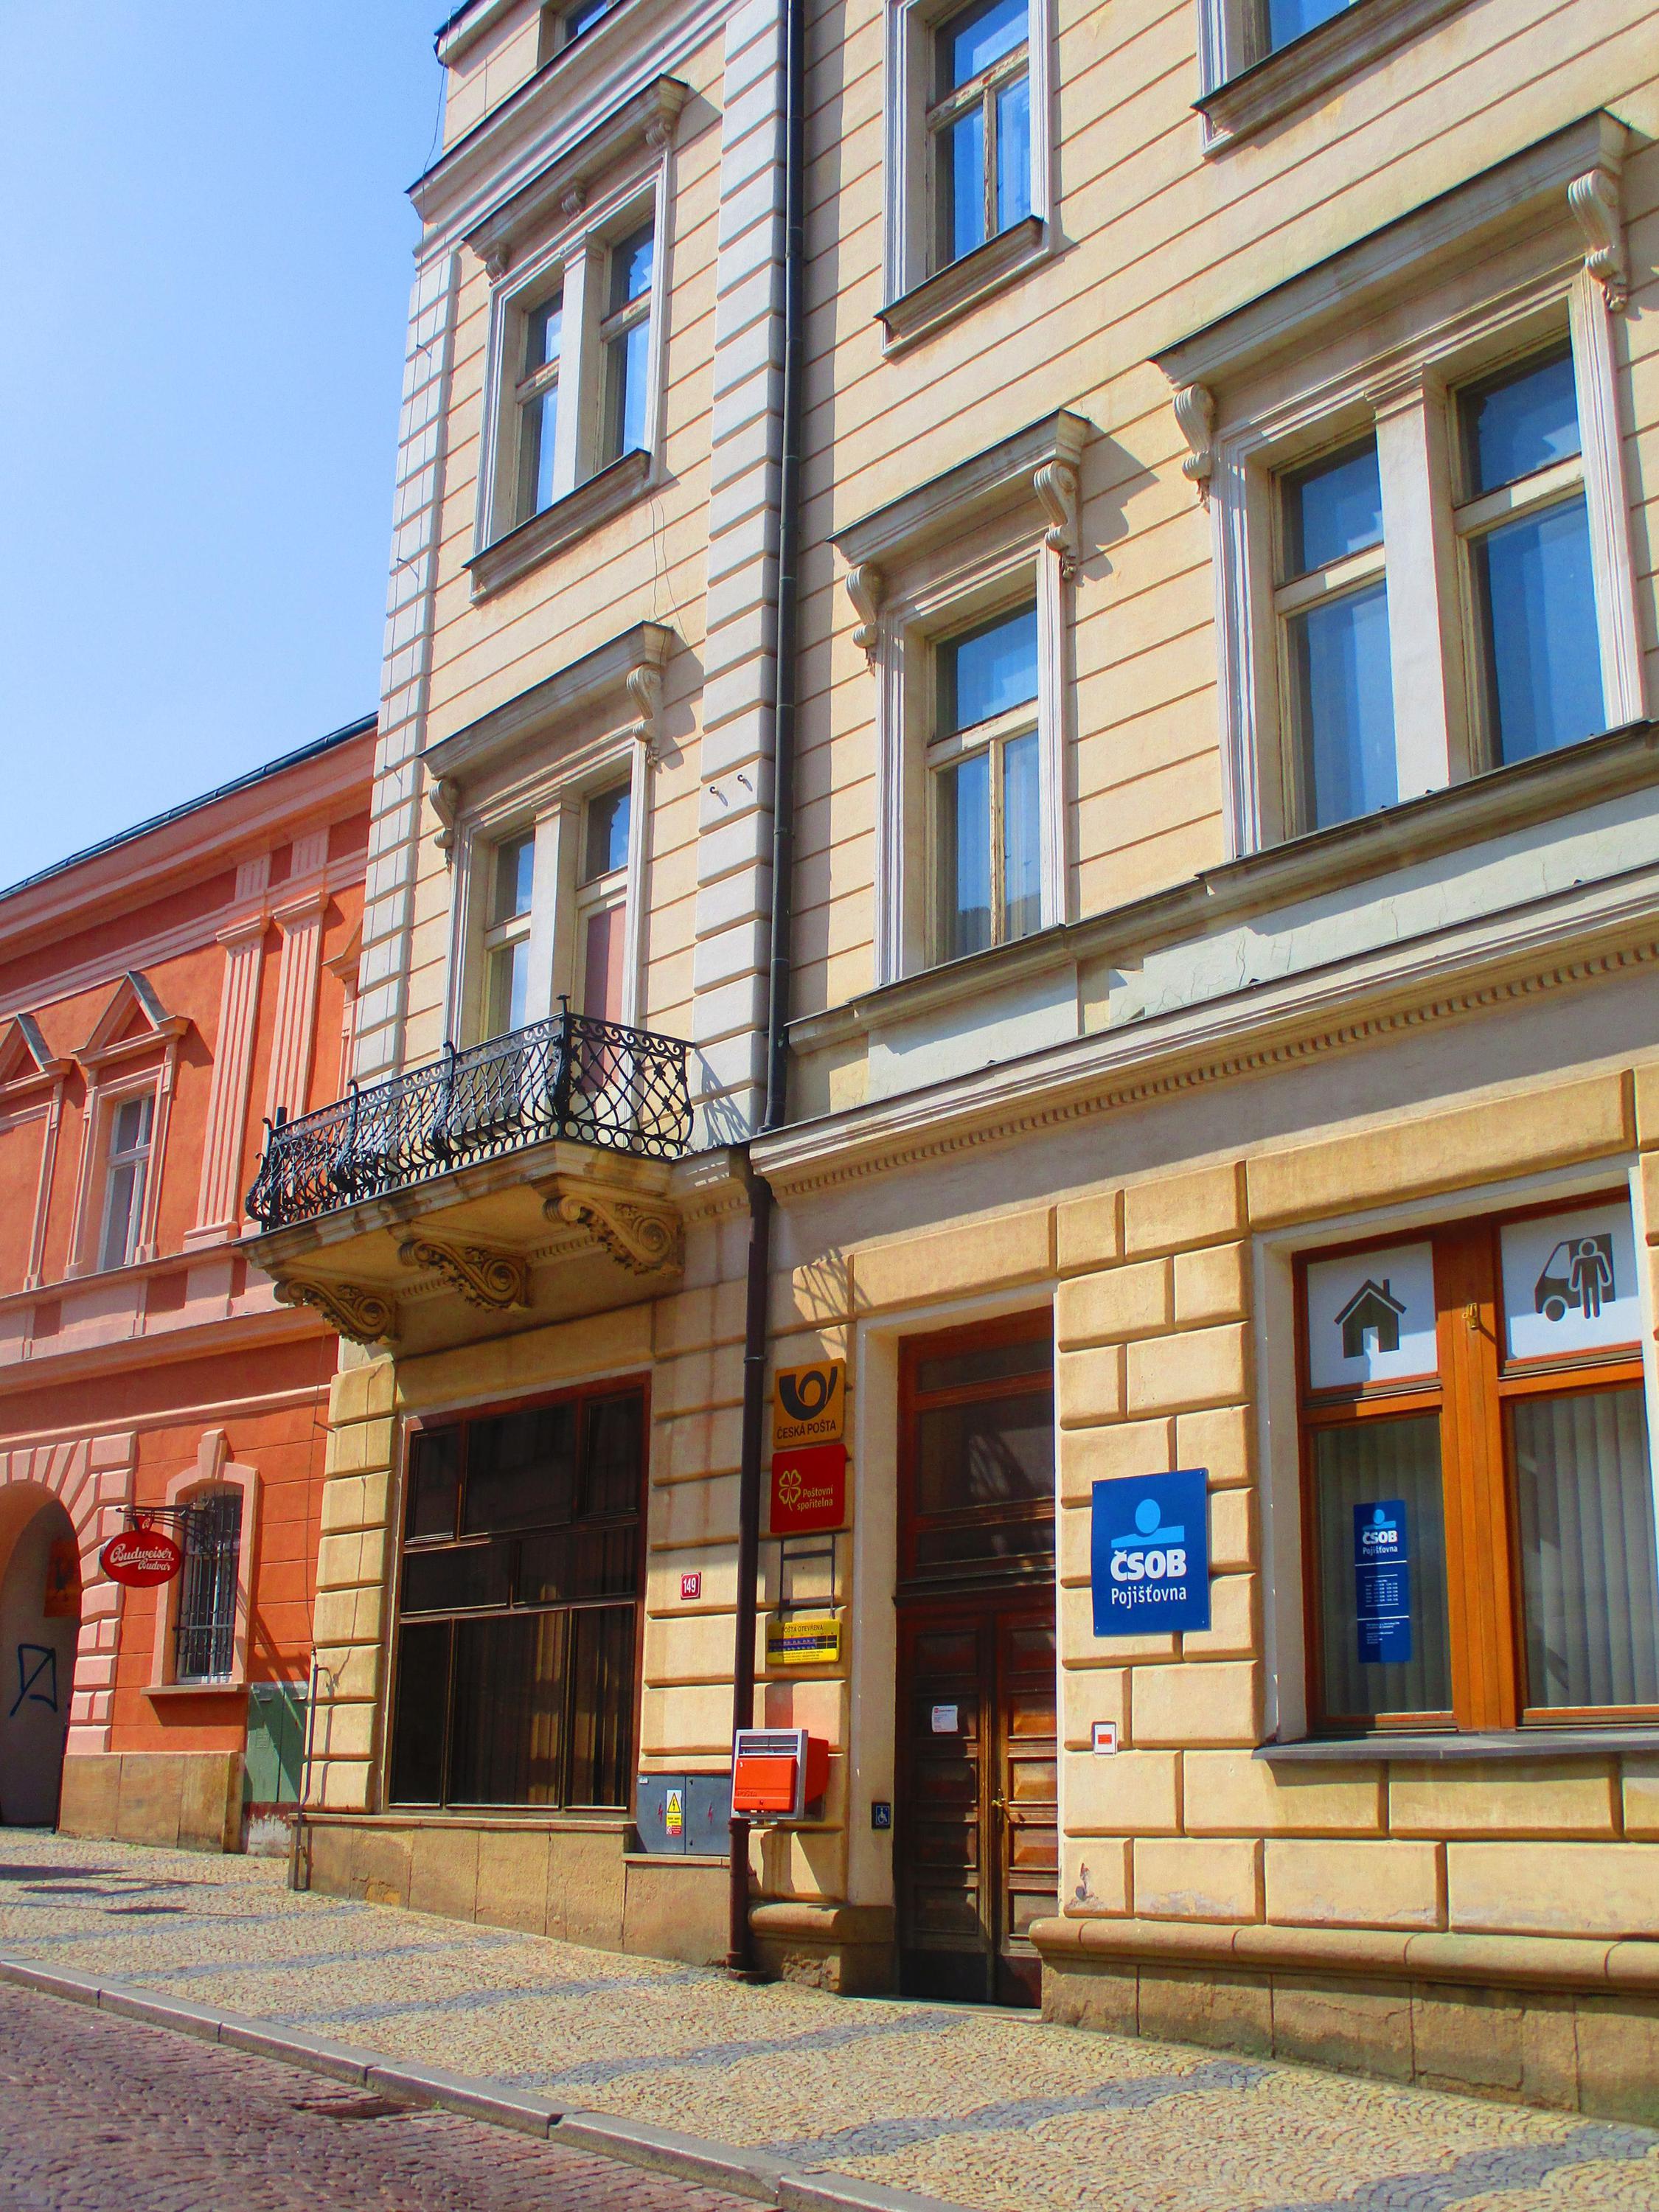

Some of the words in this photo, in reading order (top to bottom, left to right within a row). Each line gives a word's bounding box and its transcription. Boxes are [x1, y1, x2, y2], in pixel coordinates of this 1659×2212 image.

[776, 1422, 806, 1439] ČESKÁ
[807, 1419, 836, 1436] POŠTA
[802, 1484, 833, 1498] Poštovní
[797, 1497, 833, 1512] spořitelna
[1362, 1530, 1398, 1545] ČSOB
[110, 1543, 174, 1564] Budweiser
[138, 1558, 171, 1571] Budvar
[1110, 1549, 1186, 1582] ČSOB
[684, 1577, 697, 1593] 149
[1111, 1584, 1186, 1609] Pojišťovna
